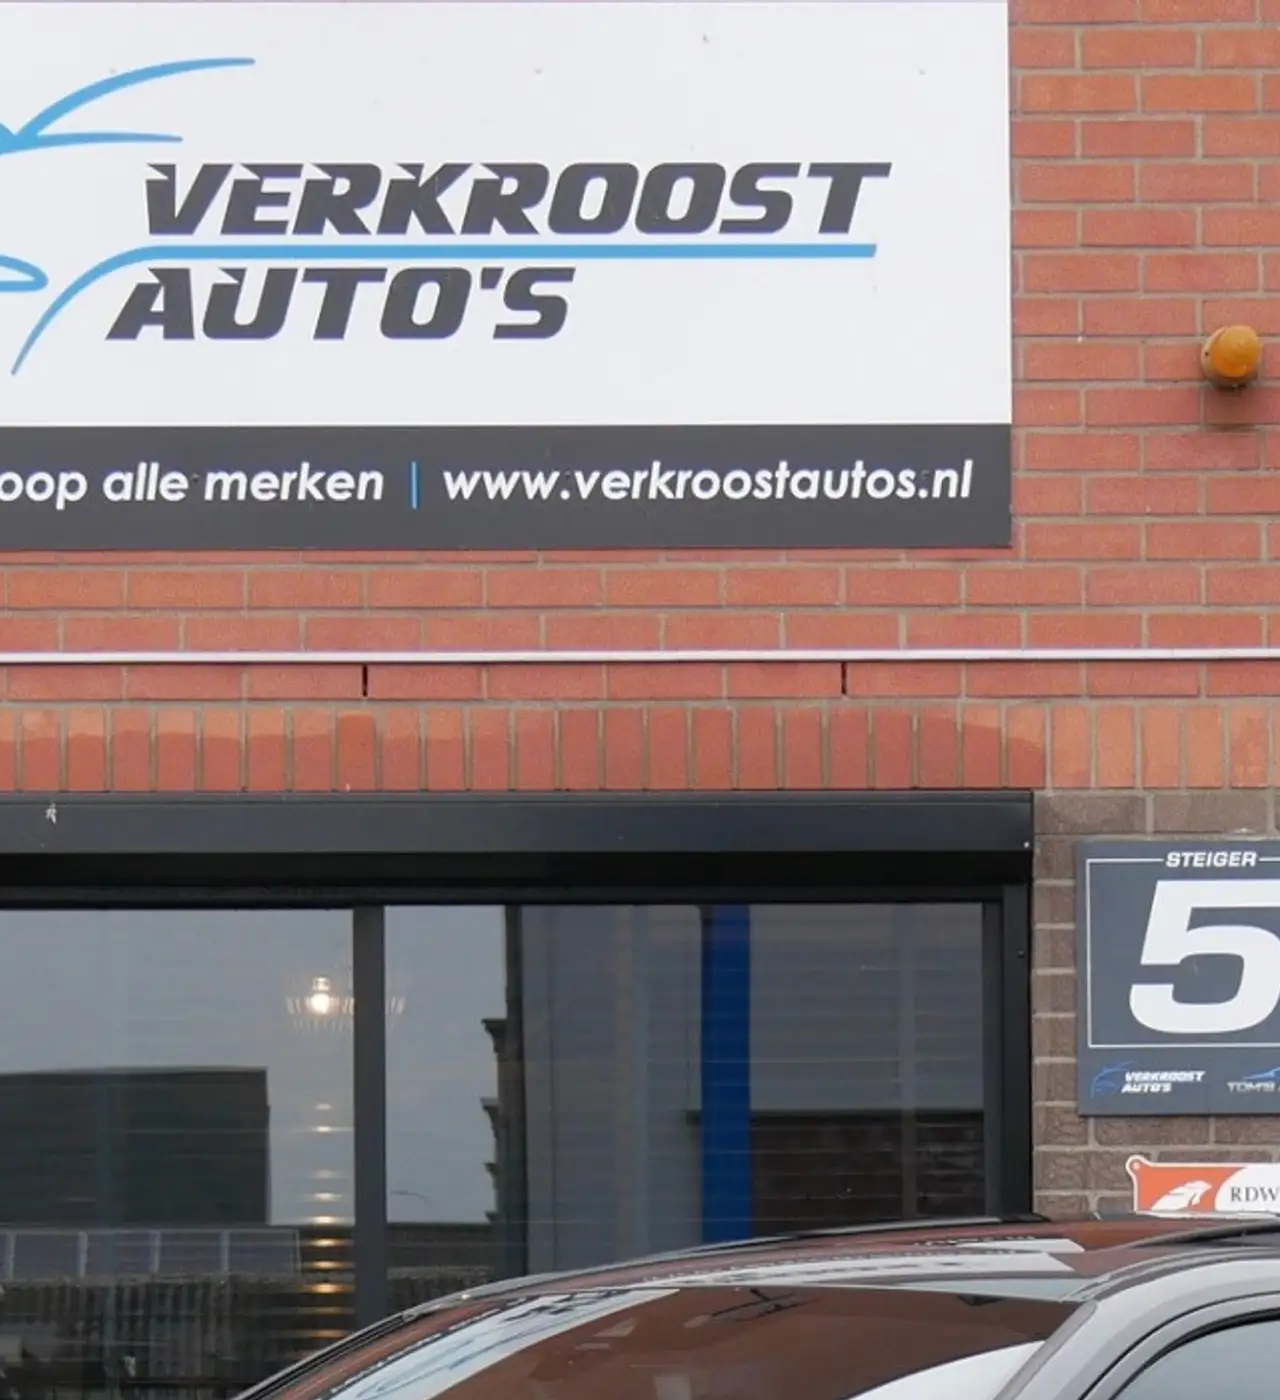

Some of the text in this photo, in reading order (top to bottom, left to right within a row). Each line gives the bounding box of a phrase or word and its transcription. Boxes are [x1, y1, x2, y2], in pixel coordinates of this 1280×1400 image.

[144, 162, 892, 235] VERKROOST
[105, 267, 576, 340] AUTO'S
[102, 461, 189, 502] alle
[204, 461, 385, 502] merken
[442, 459, 973, 501] www.verkroostautos.nl
[1165, 850, 1258, 868] STEIGER
[1123, 1070, 1206, 1083] VERKROOST
